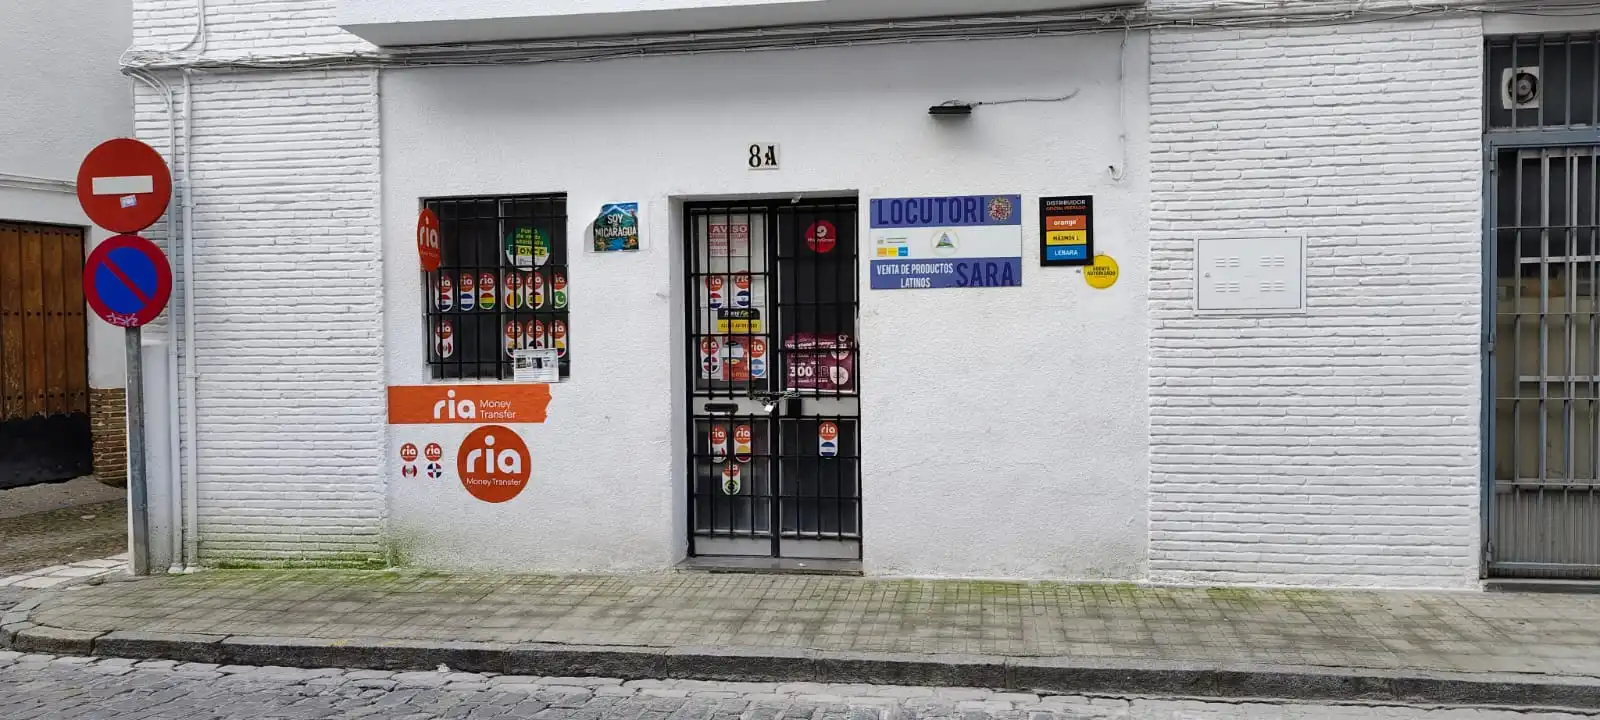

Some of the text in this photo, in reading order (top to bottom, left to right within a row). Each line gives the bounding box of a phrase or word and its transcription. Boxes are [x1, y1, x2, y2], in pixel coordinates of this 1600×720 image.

[607, 213, 623, 224] SOY
[595, 226, 637, 238] NICARAGUA
[712, 225, 748, 233] AVSO
[877, 263, 953, 275] VENTA DE PRODUCTOS
[956, 262, 1014, 287] SARA
[480, 275, 494, 285] ria
[900, 278, 931, 288] LATINOS
[433, 389, 511, 419] ria Money
[480, 410, 515, 419] Transfer
[402, 445, 416, 456] ria
[426, 444, 441, 455] ria
[466, 435, 521, 473] ria
[466, 477, 521, 487] Money Transfer
